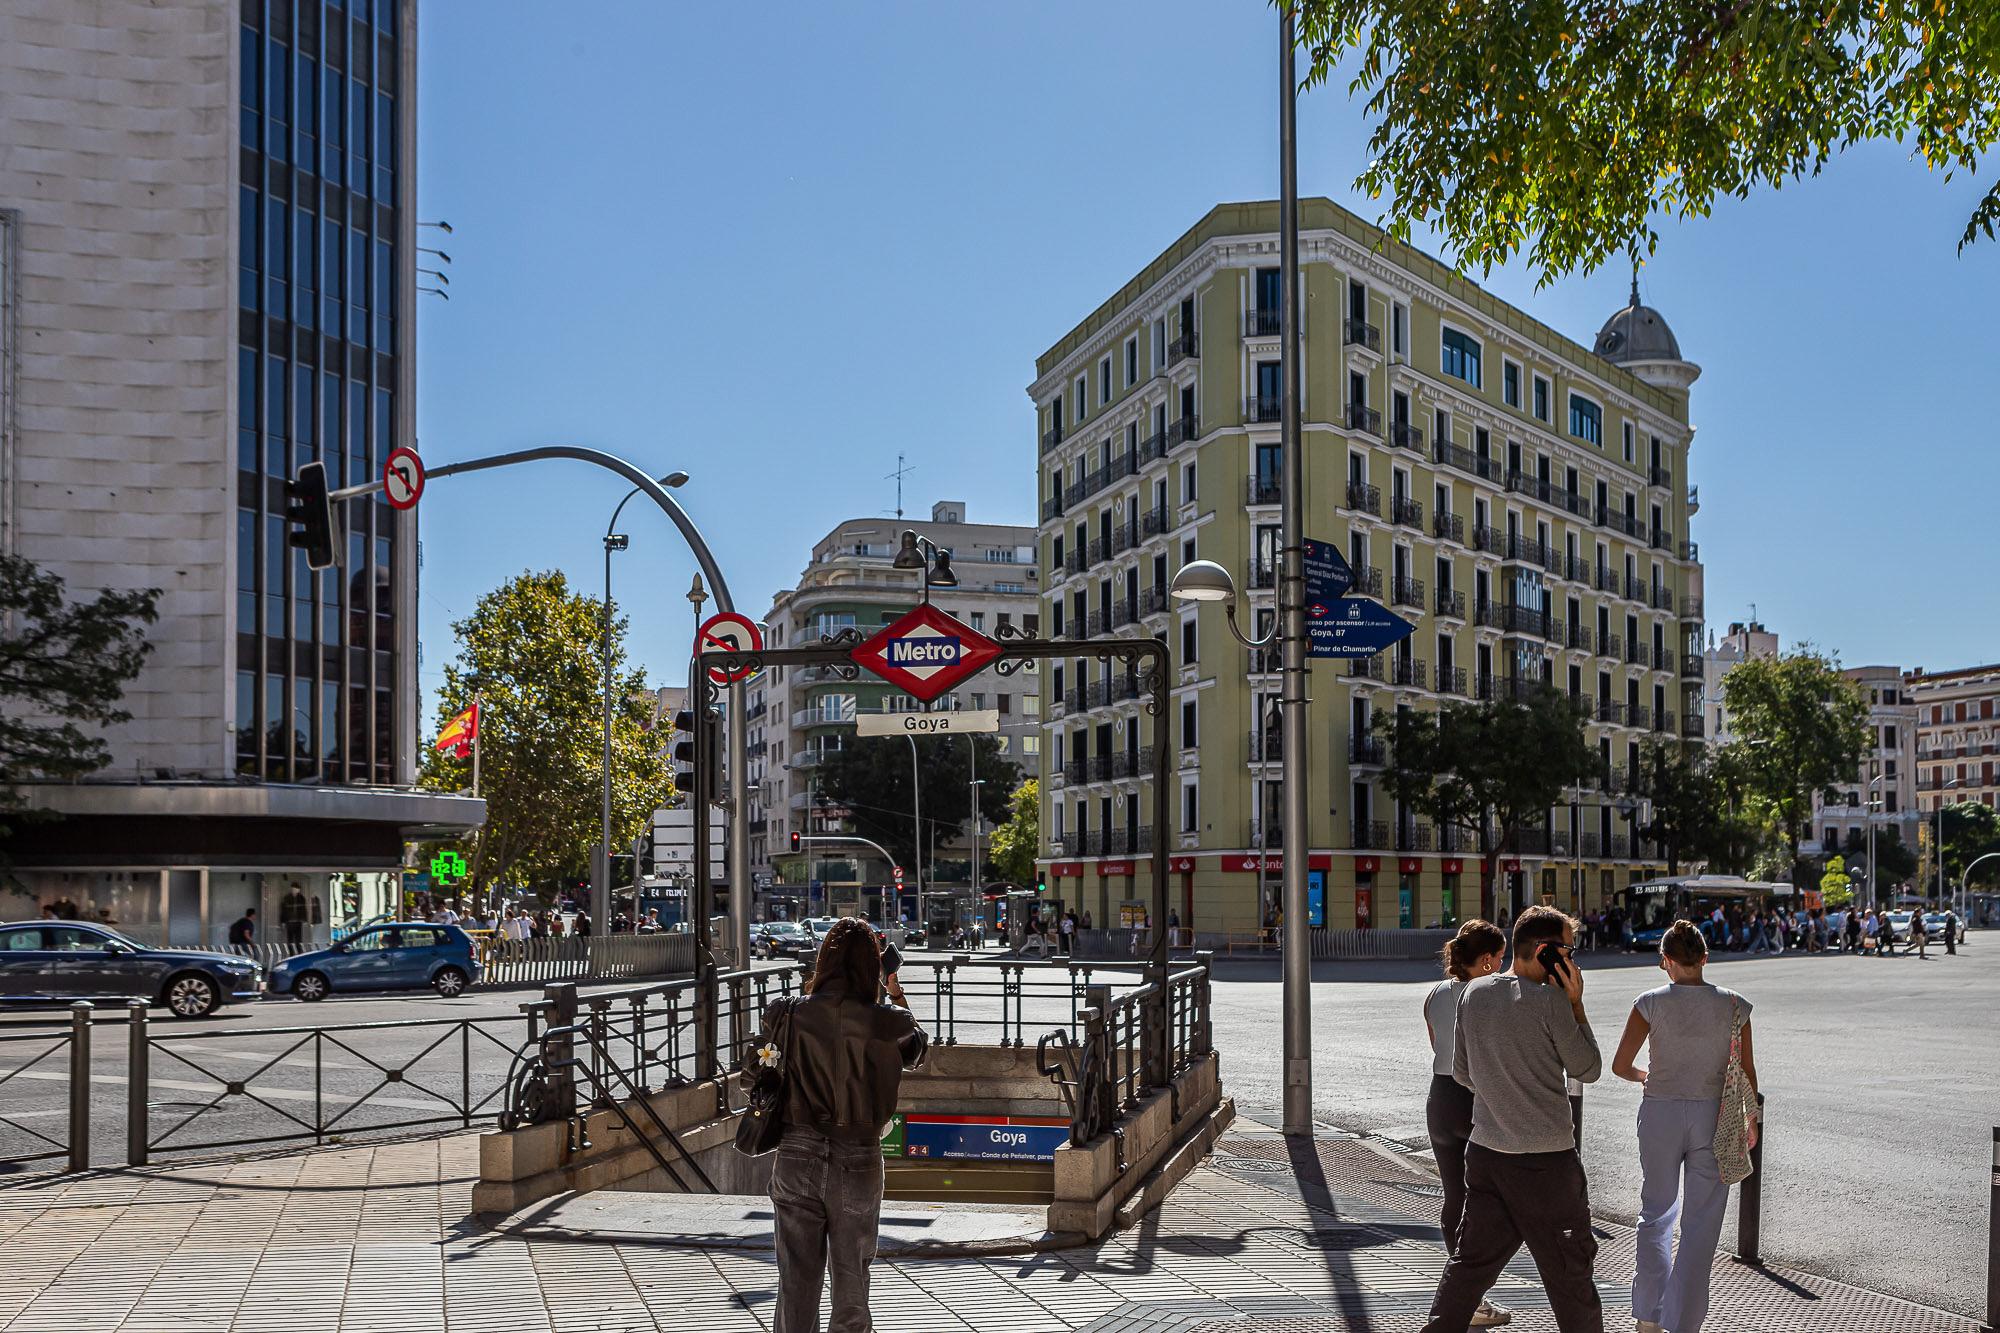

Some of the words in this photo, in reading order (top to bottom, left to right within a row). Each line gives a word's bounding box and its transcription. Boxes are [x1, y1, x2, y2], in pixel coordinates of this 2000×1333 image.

[1310, 629, 1334, 638] Goya,
[893, 642, 956, 661] Metro
[904, 716, 950, 732] Goya
[651, 888, 660, 897] E4
[990, 1129, 1027, 1146] Goya
[910, 1146, 916, 1154] 2
[921, 1146, 927, 1155] 4
[1010, 1152, 1037, 1160] Peñalver,
